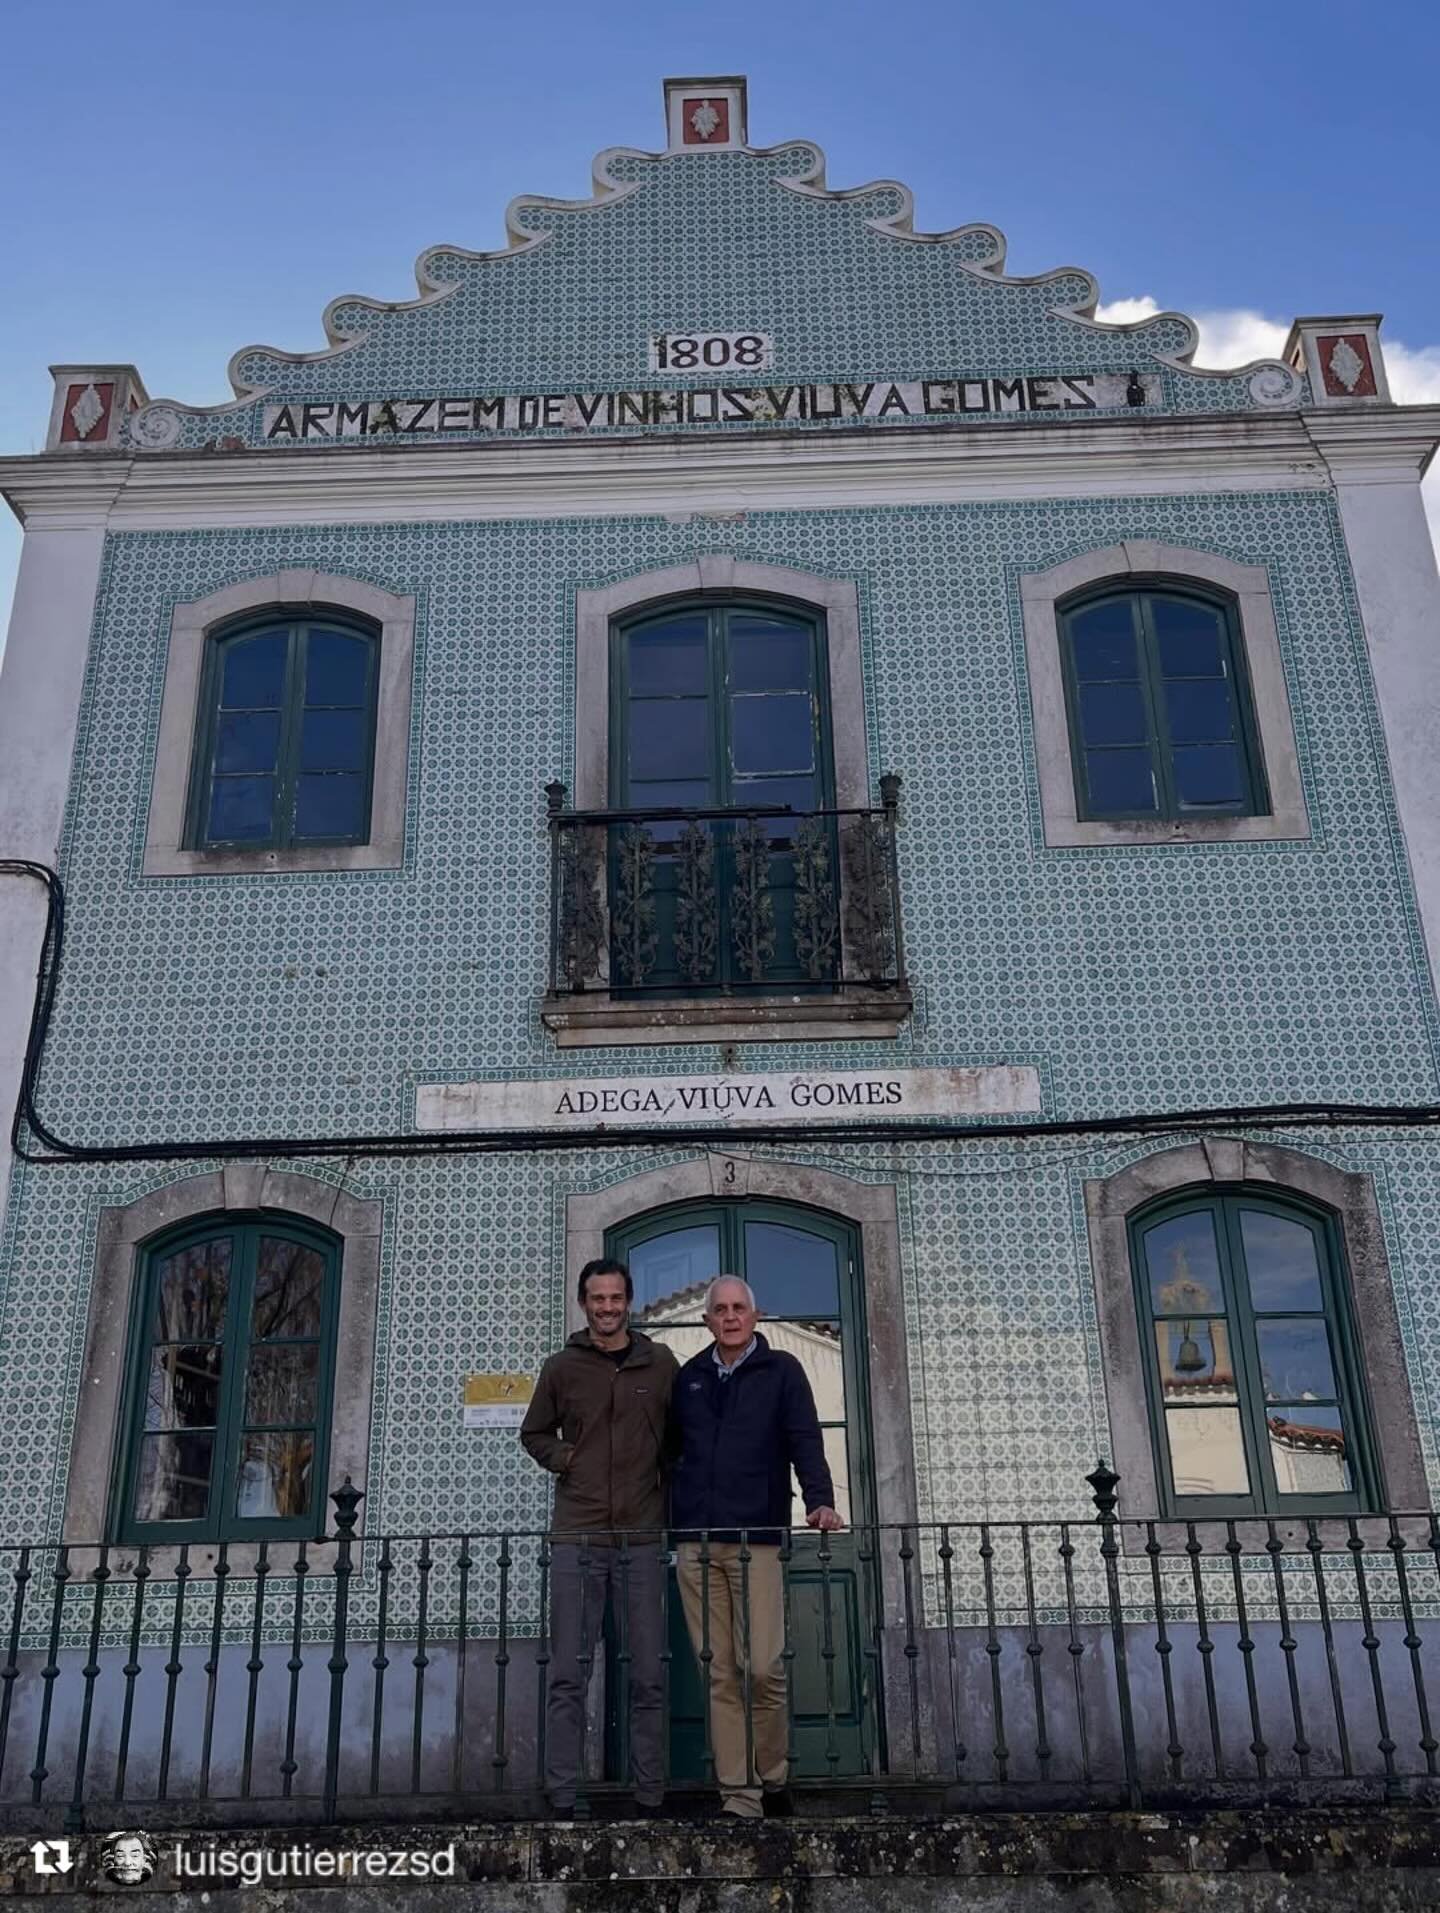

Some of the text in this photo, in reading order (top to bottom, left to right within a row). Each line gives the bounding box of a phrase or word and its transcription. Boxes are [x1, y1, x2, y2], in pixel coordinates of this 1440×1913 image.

[653, 335, 764, 368] 1808
[267, 375, 1097, 438] ARMAZEM DE VINHOS VIUVA GOMES
[554, 1088, 664, 1115] ADEGA
[790, 1081, 903, 1108] GOMES
[724, 1161, 736, 1184] 3
